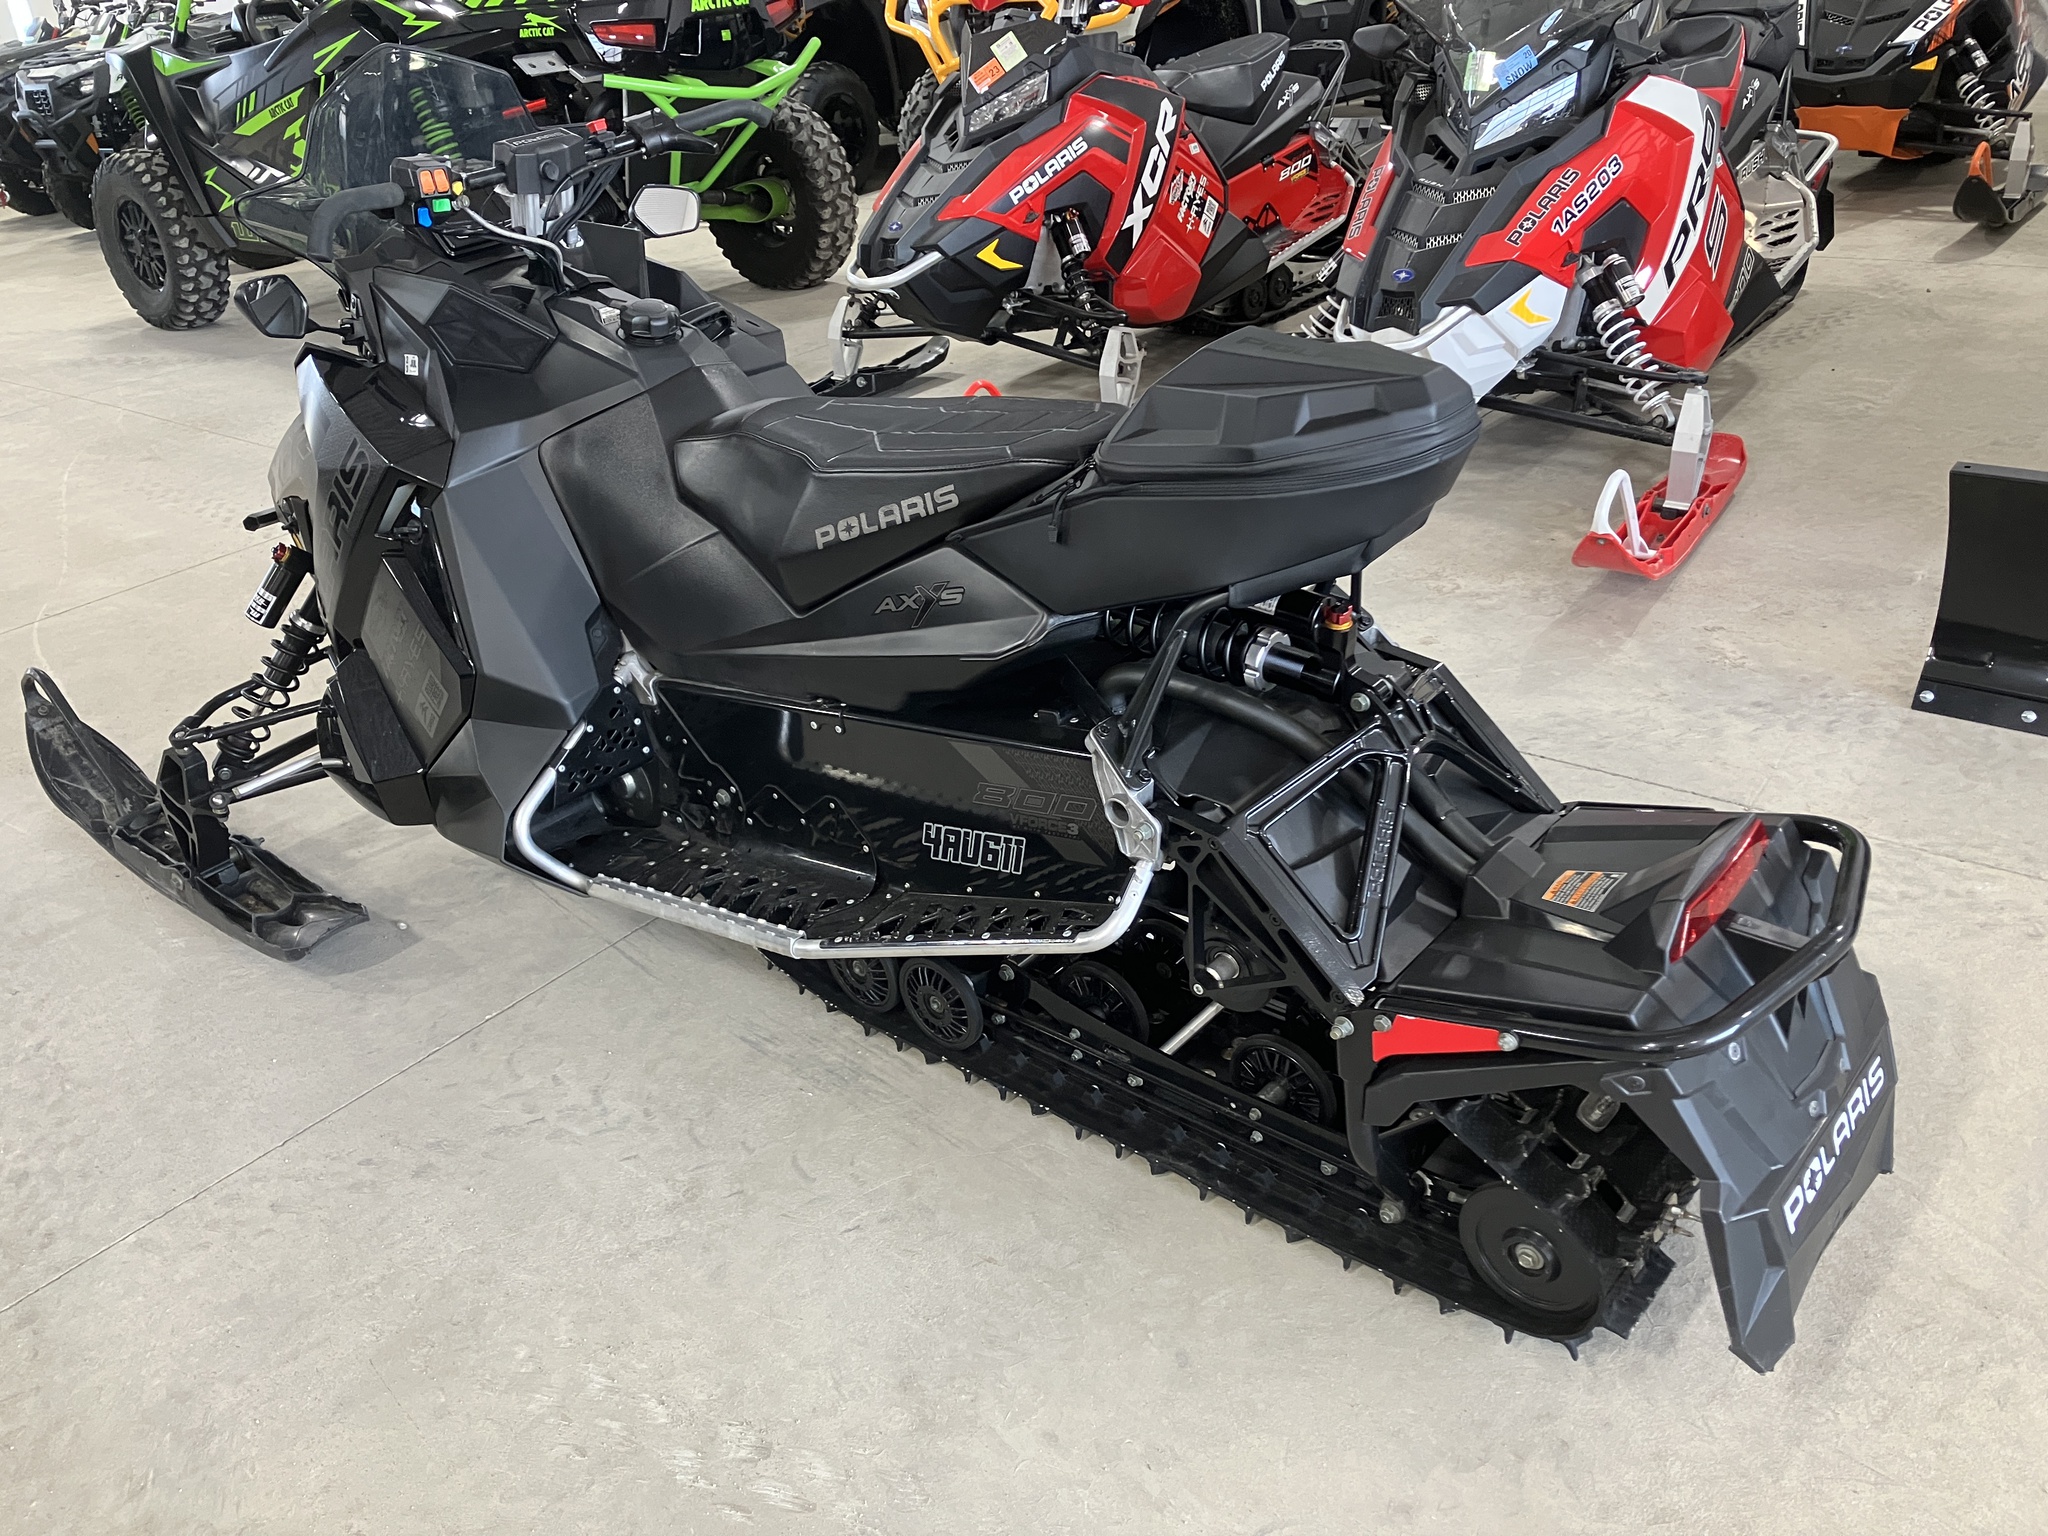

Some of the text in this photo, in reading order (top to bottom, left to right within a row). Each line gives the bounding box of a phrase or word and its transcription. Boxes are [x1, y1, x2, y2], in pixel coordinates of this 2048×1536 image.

[519, 26, 555, 38] ARCTIC CAT
[1912, 0, 1953, 31] POL
[988, 65, 1000, 78] 23
[1260, 50, 1286, 92] POLARIS
[1504, 60, 1534, 86] SNOW
[268, 96, 295, 119] ARCTIC CAT
[1008, 136, 1089, 206] POLARIS
[1121, 97, 1177, 249] XCR
[1278, 153, 1313, 182] 800
[1347, 164, 1387, 240] POLARIS
[1504, 167, 1582, 247] POLARIS
[1551, 153, 1624, 237] 1AS203
[1663, 104, 1717, 290] PRO
[814, 483, 960, 550] POLARIS
[872, 580, 966, 629] AXYS
[972, 781, 1098, 822] 800
[922, 821, 1026, 875] 4AU611
[1783, 1055, 1885, 1235] POLARIS
